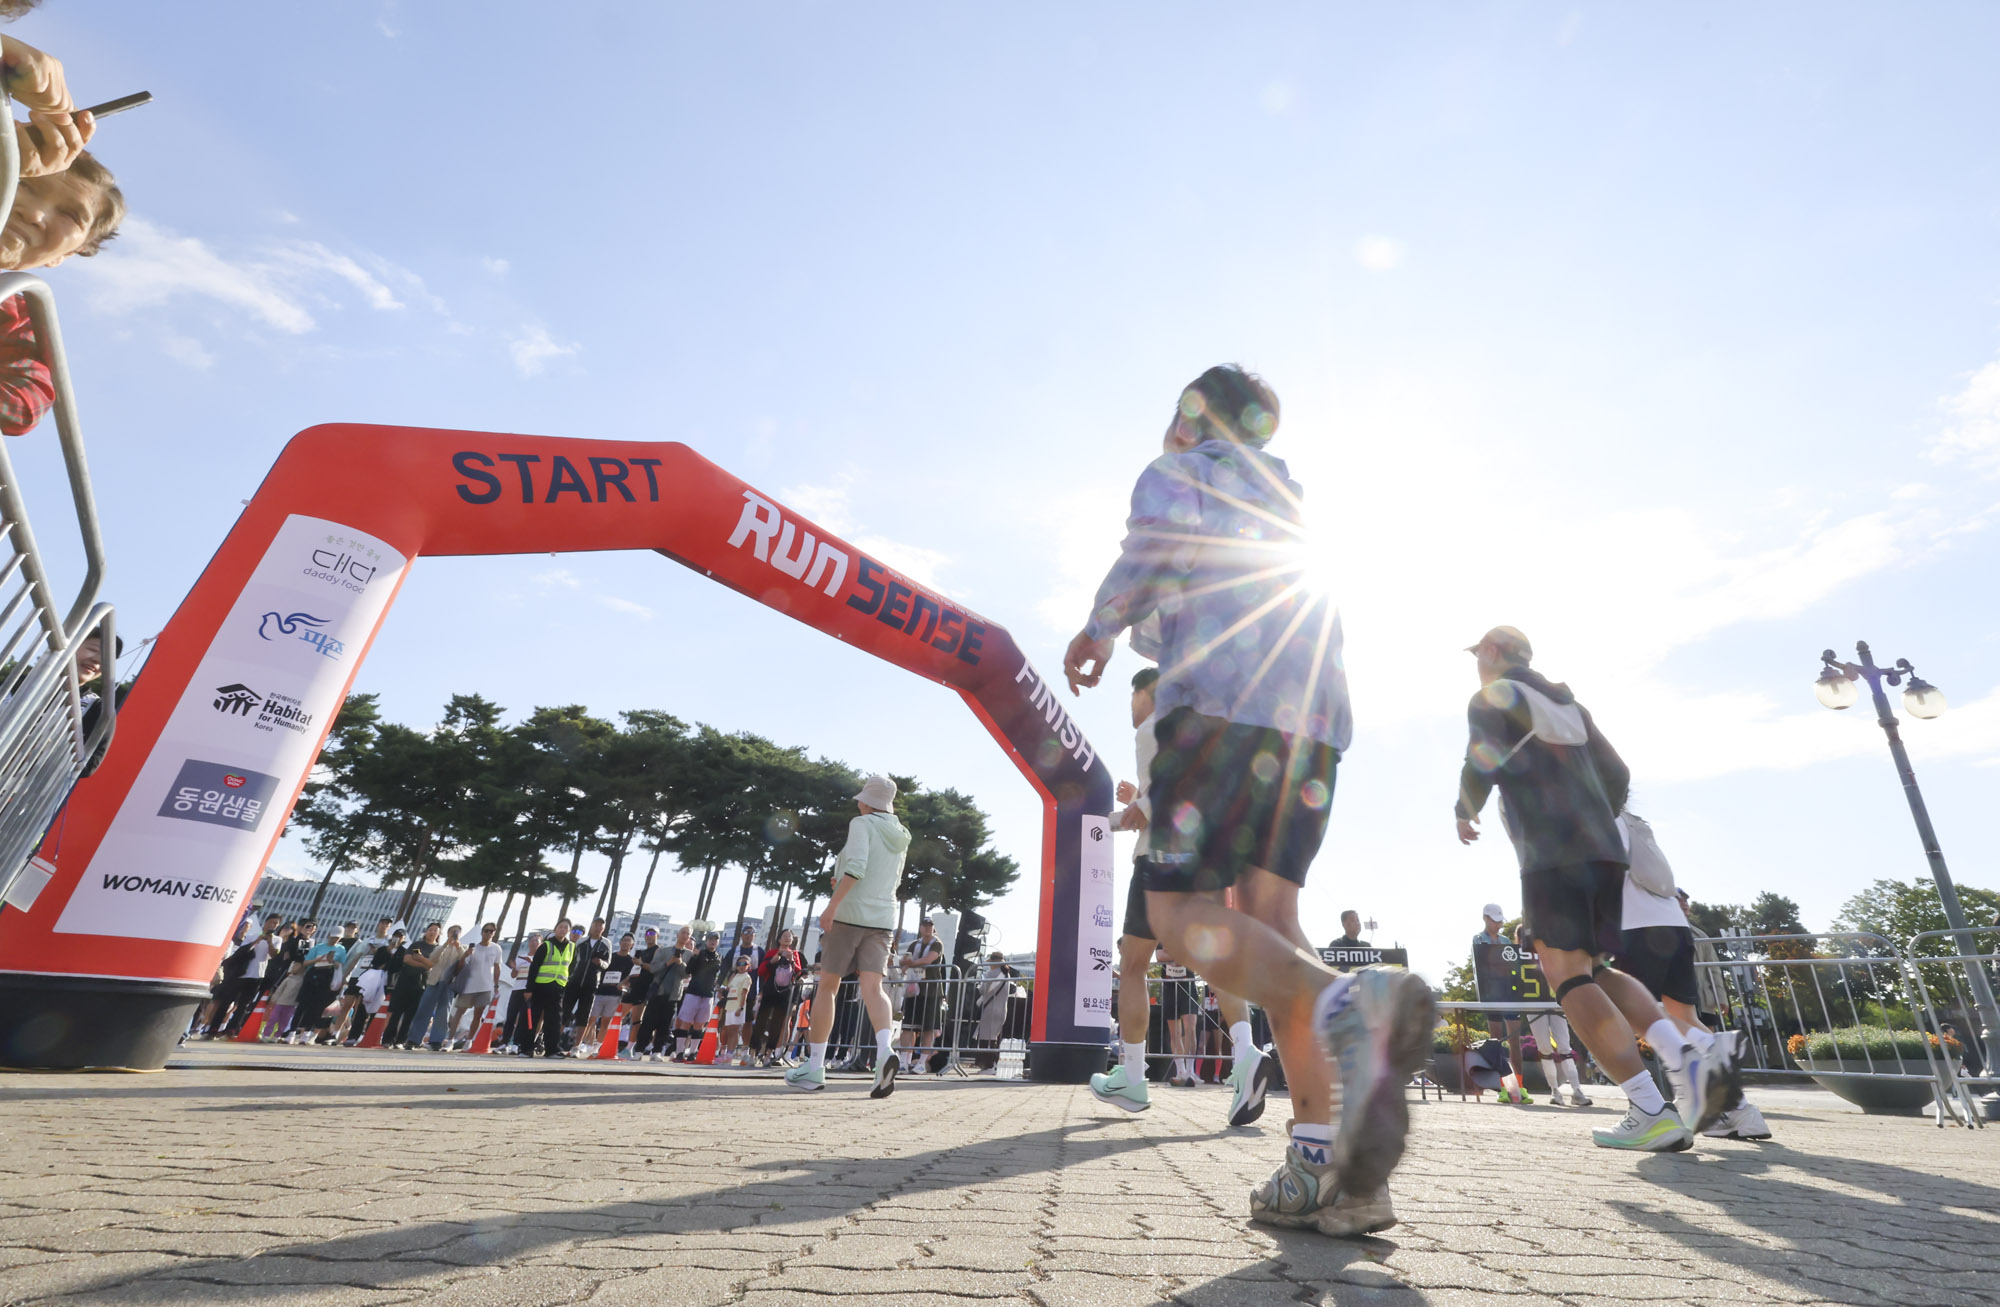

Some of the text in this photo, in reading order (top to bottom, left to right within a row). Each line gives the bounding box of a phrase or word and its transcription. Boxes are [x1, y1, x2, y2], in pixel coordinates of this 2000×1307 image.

[452, 451, 663, 504] START
[303, 567, 365, 595] daddy food
[258, 713, 308, 735] for Humanity
[262, 699, 313, 726] Habitat
[1015, 659, 1096, 773] FINISH
[253, 721, 274, 733] Korea
[173, 786, 262, 823] 동원샘물
[102, 873, 238, 904] WOMAN SENSE
[1323, 950, 1382, 963] SAMIK
